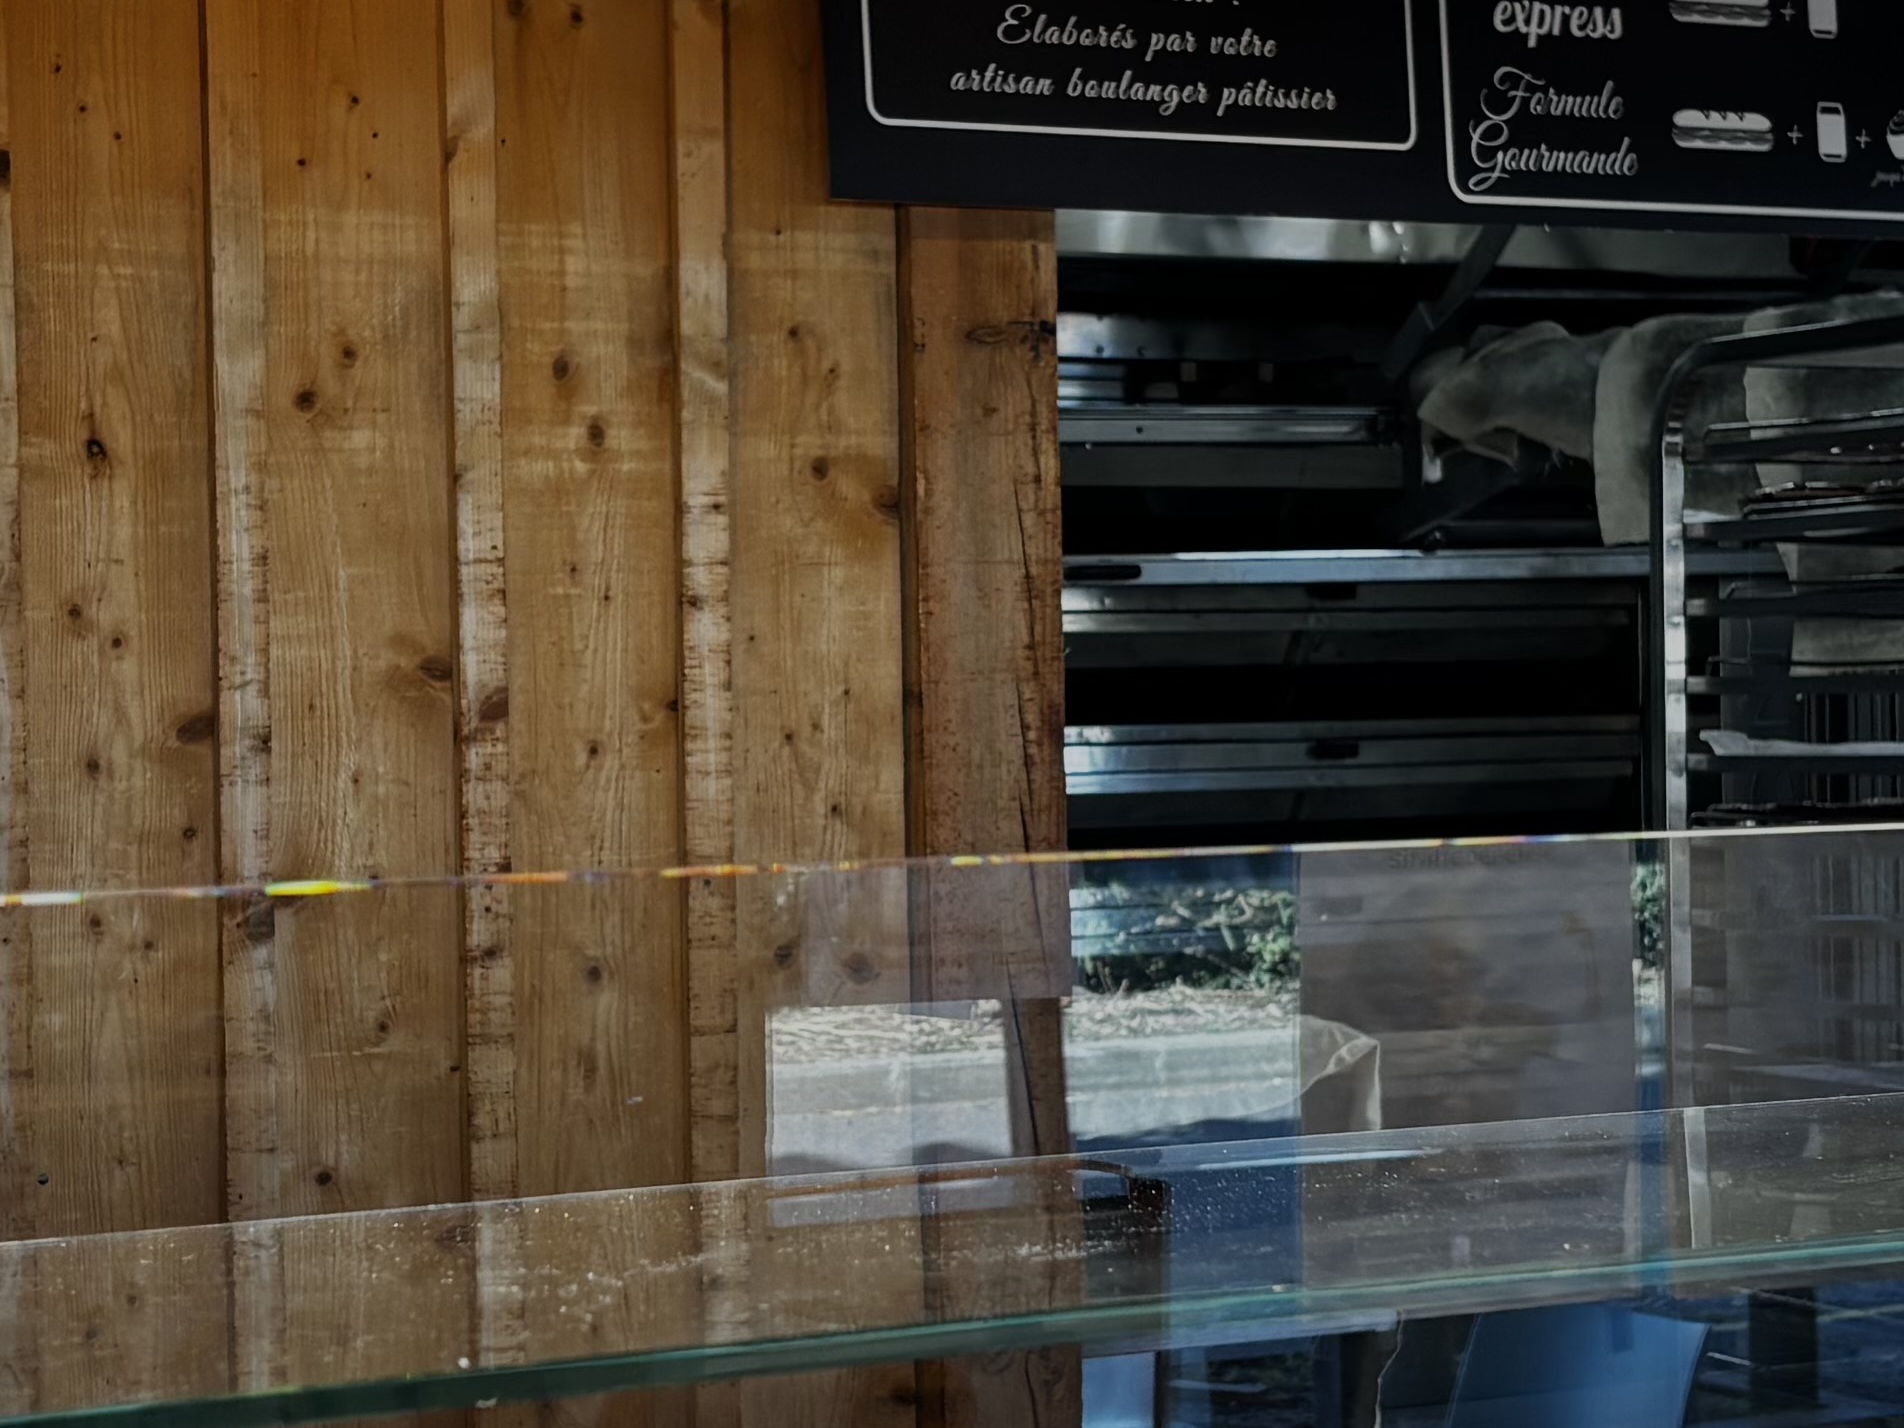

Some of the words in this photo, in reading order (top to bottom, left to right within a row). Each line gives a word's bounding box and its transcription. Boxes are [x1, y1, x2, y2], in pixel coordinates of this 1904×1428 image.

[997, 3, 1137, 49] Elaborés
[1145, 31, 1197, 61] par
[1209, 28, 1278, 58] votre
[950, 64, 1054, 97] artisan
[1067, 67, 1209, 116] boulanger
[1217, 79, 1338, 117] pâtissier
[1480, 65, 1625, 122] Formule
[1468, 116, 1639, 191] Gourmande
